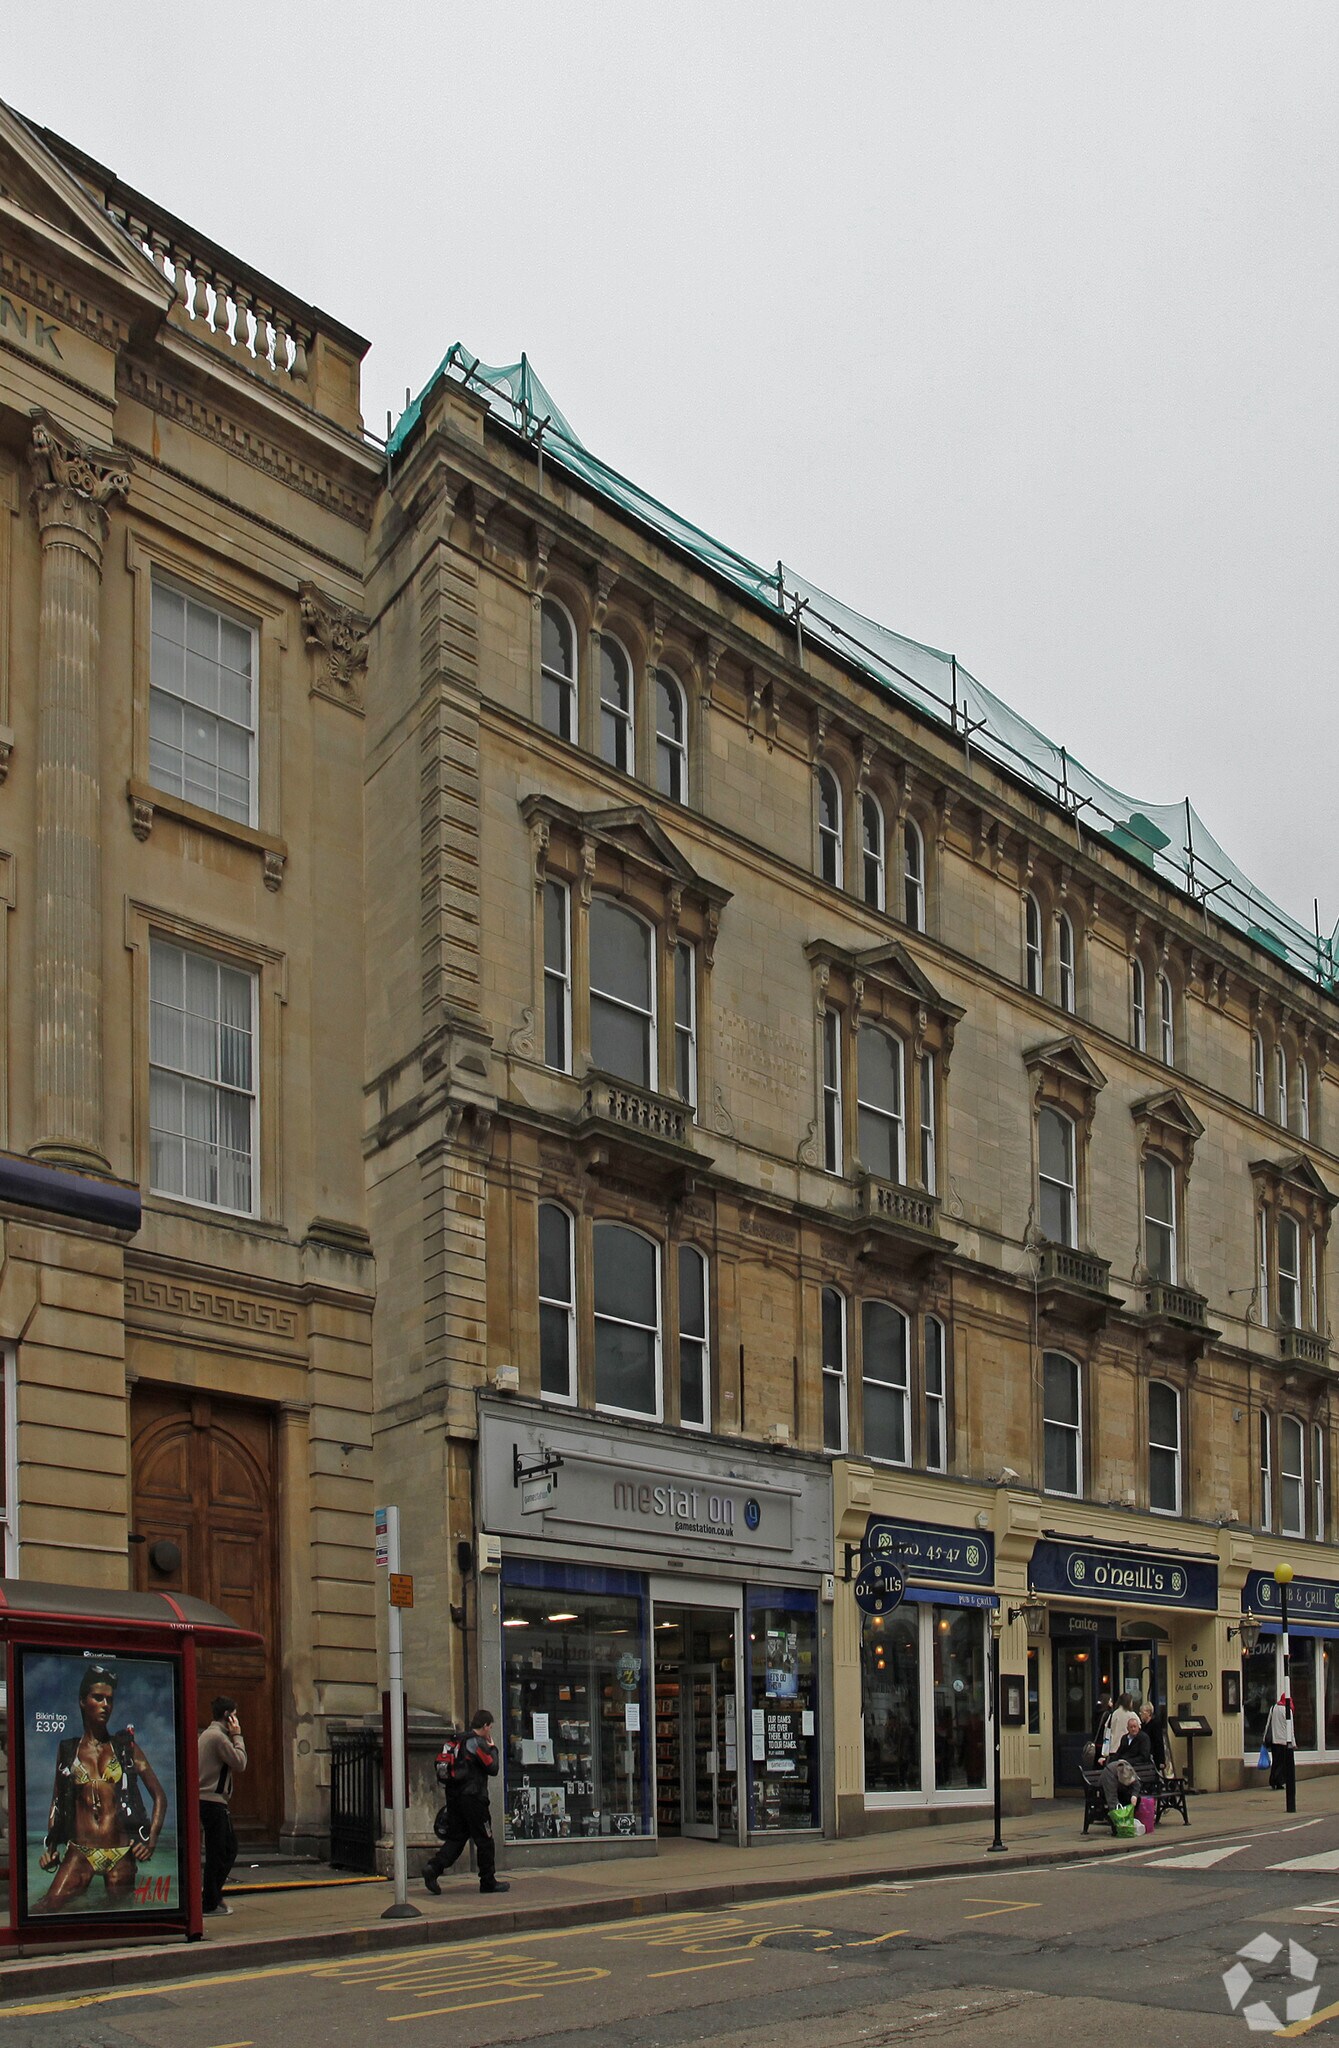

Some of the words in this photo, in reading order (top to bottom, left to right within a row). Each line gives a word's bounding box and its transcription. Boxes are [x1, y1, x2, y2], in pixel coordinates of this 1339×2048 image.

[674, 1520, 734, 1537] gamestation.co.uk
[35, 1711, 55, 1721] Bikini
[55, 1713, 68, 1722] top
[767, 1715, 777, 1724] OUR
[777, 1716, 791, 1724] GAMES
[35, 1721, 66, 1733] £3.99
[767, 1723, 777, 1732] ARE
[777, 1724, 788, 1732] OVER
[782, 1732, 793, 1740] NEXT
[768, 1740, 775, 1749] TO
[774, 1741, 783, 1749] OUR
[133, 1875, 171, 1905] H&M
[310, 1950, 612, 1998] STOP
